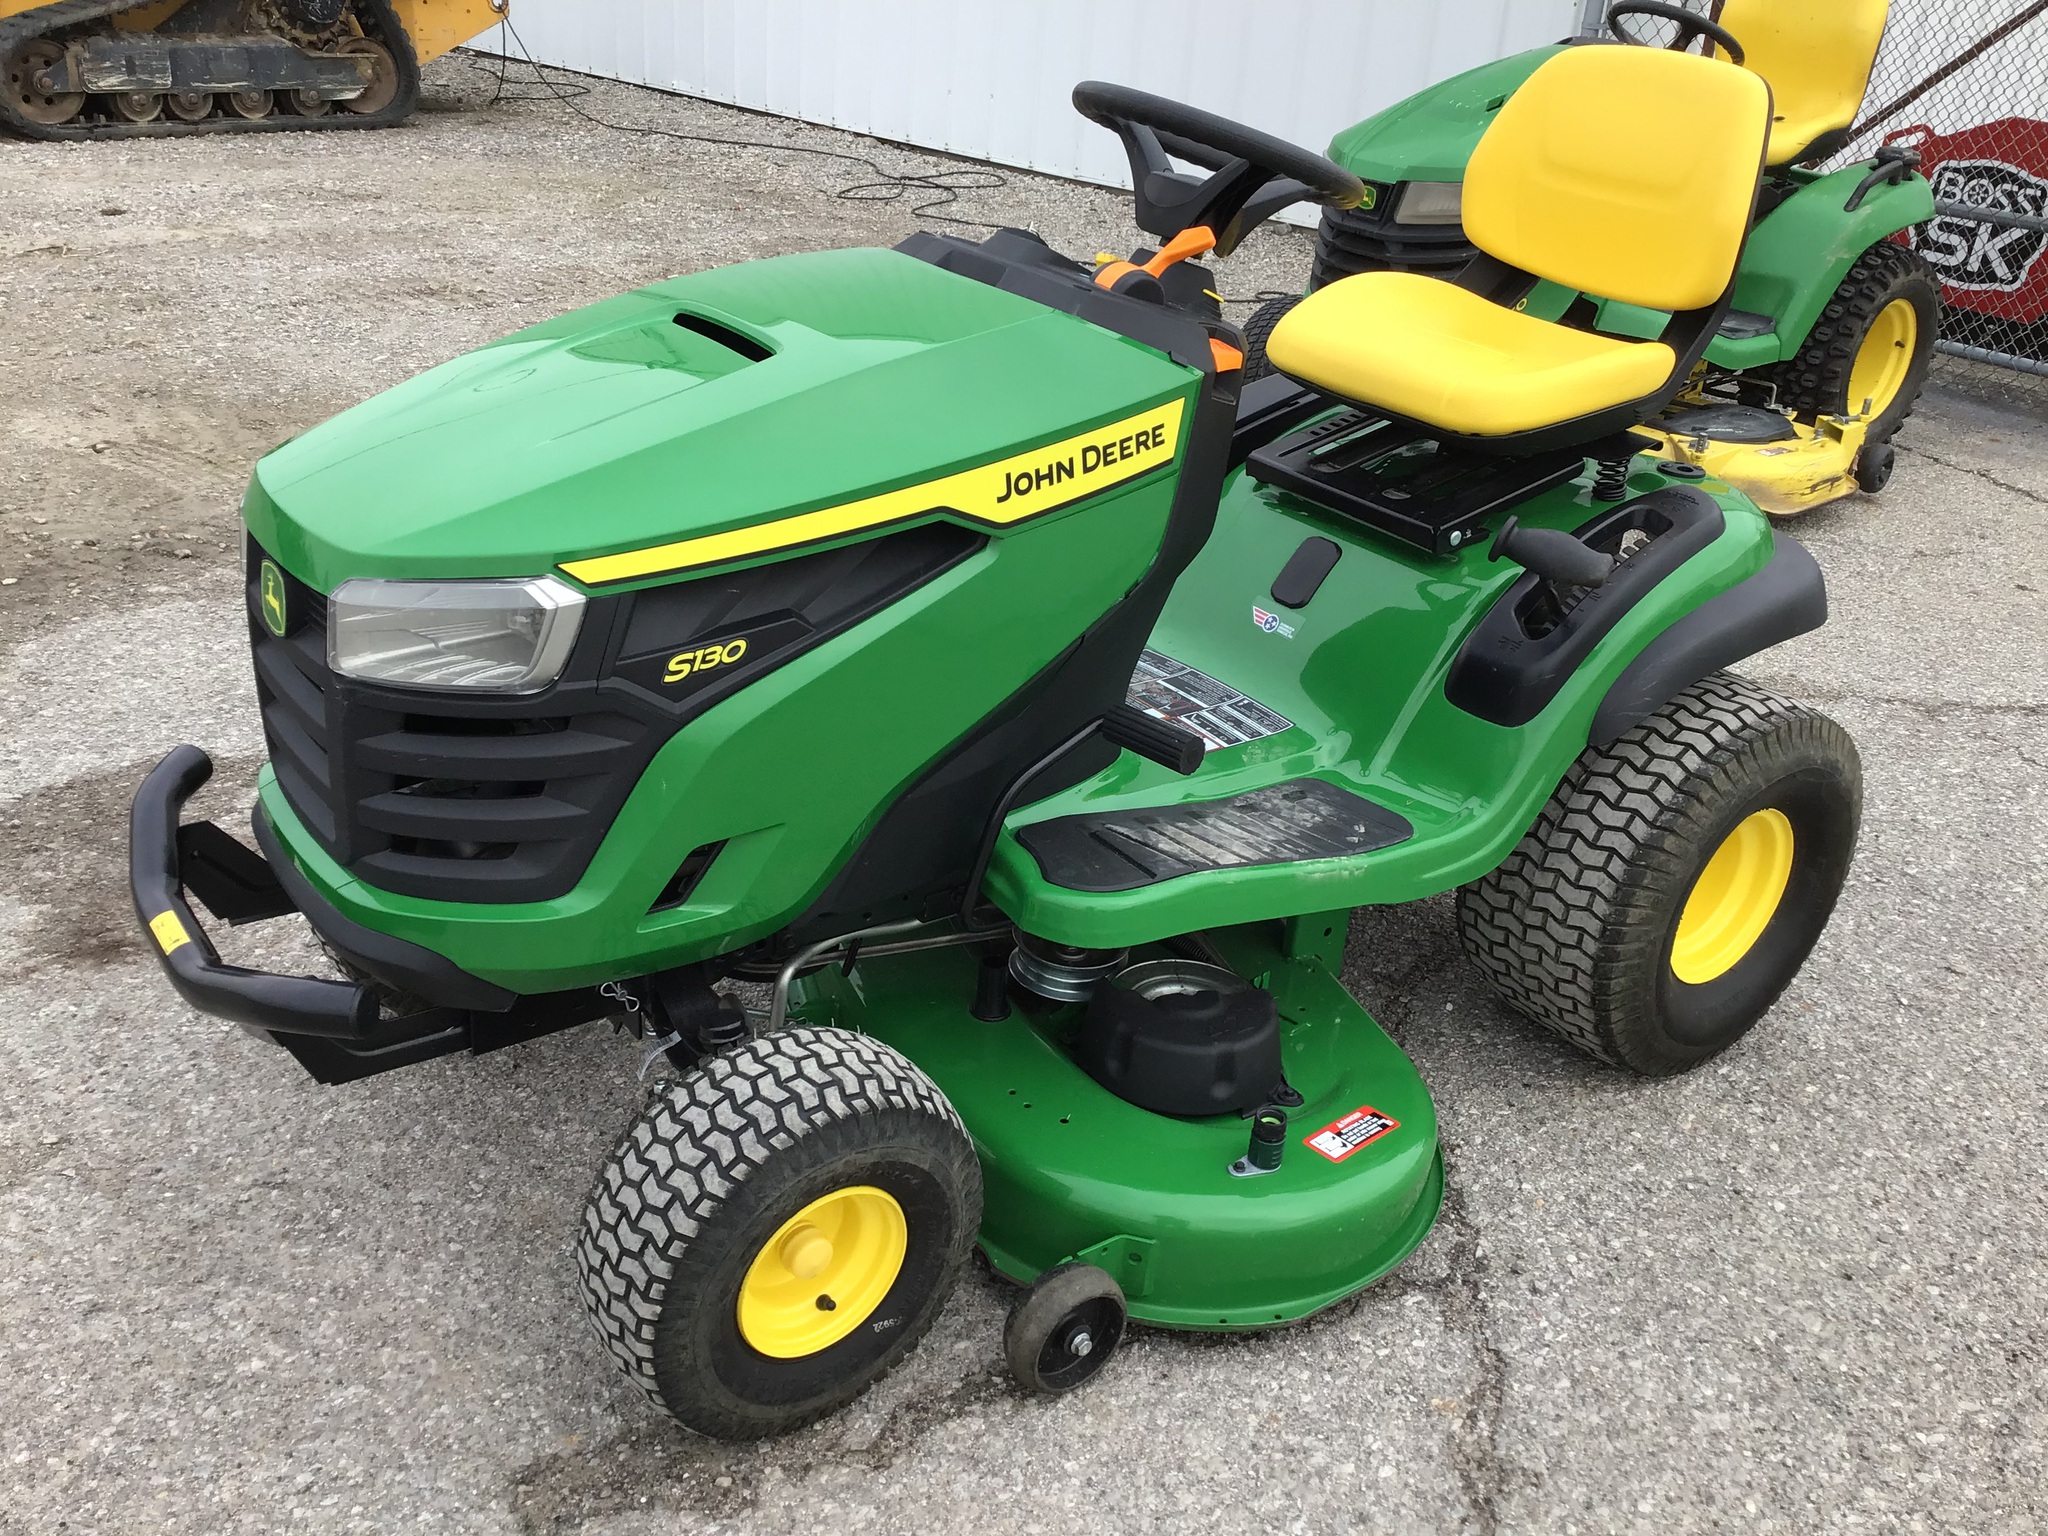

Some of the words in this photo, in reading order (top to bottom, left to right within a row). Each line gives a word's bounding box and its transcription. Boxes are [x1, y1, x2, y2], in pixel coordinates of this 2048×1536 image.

[1936, 171, 2042, 217] BOSS
[1919, 214, 2031, 281] SK
[996, 456, 1075, 504] JOHN
[1081, 422, 1166, 475] DEERE
[663, 639, 748, 683] S130
